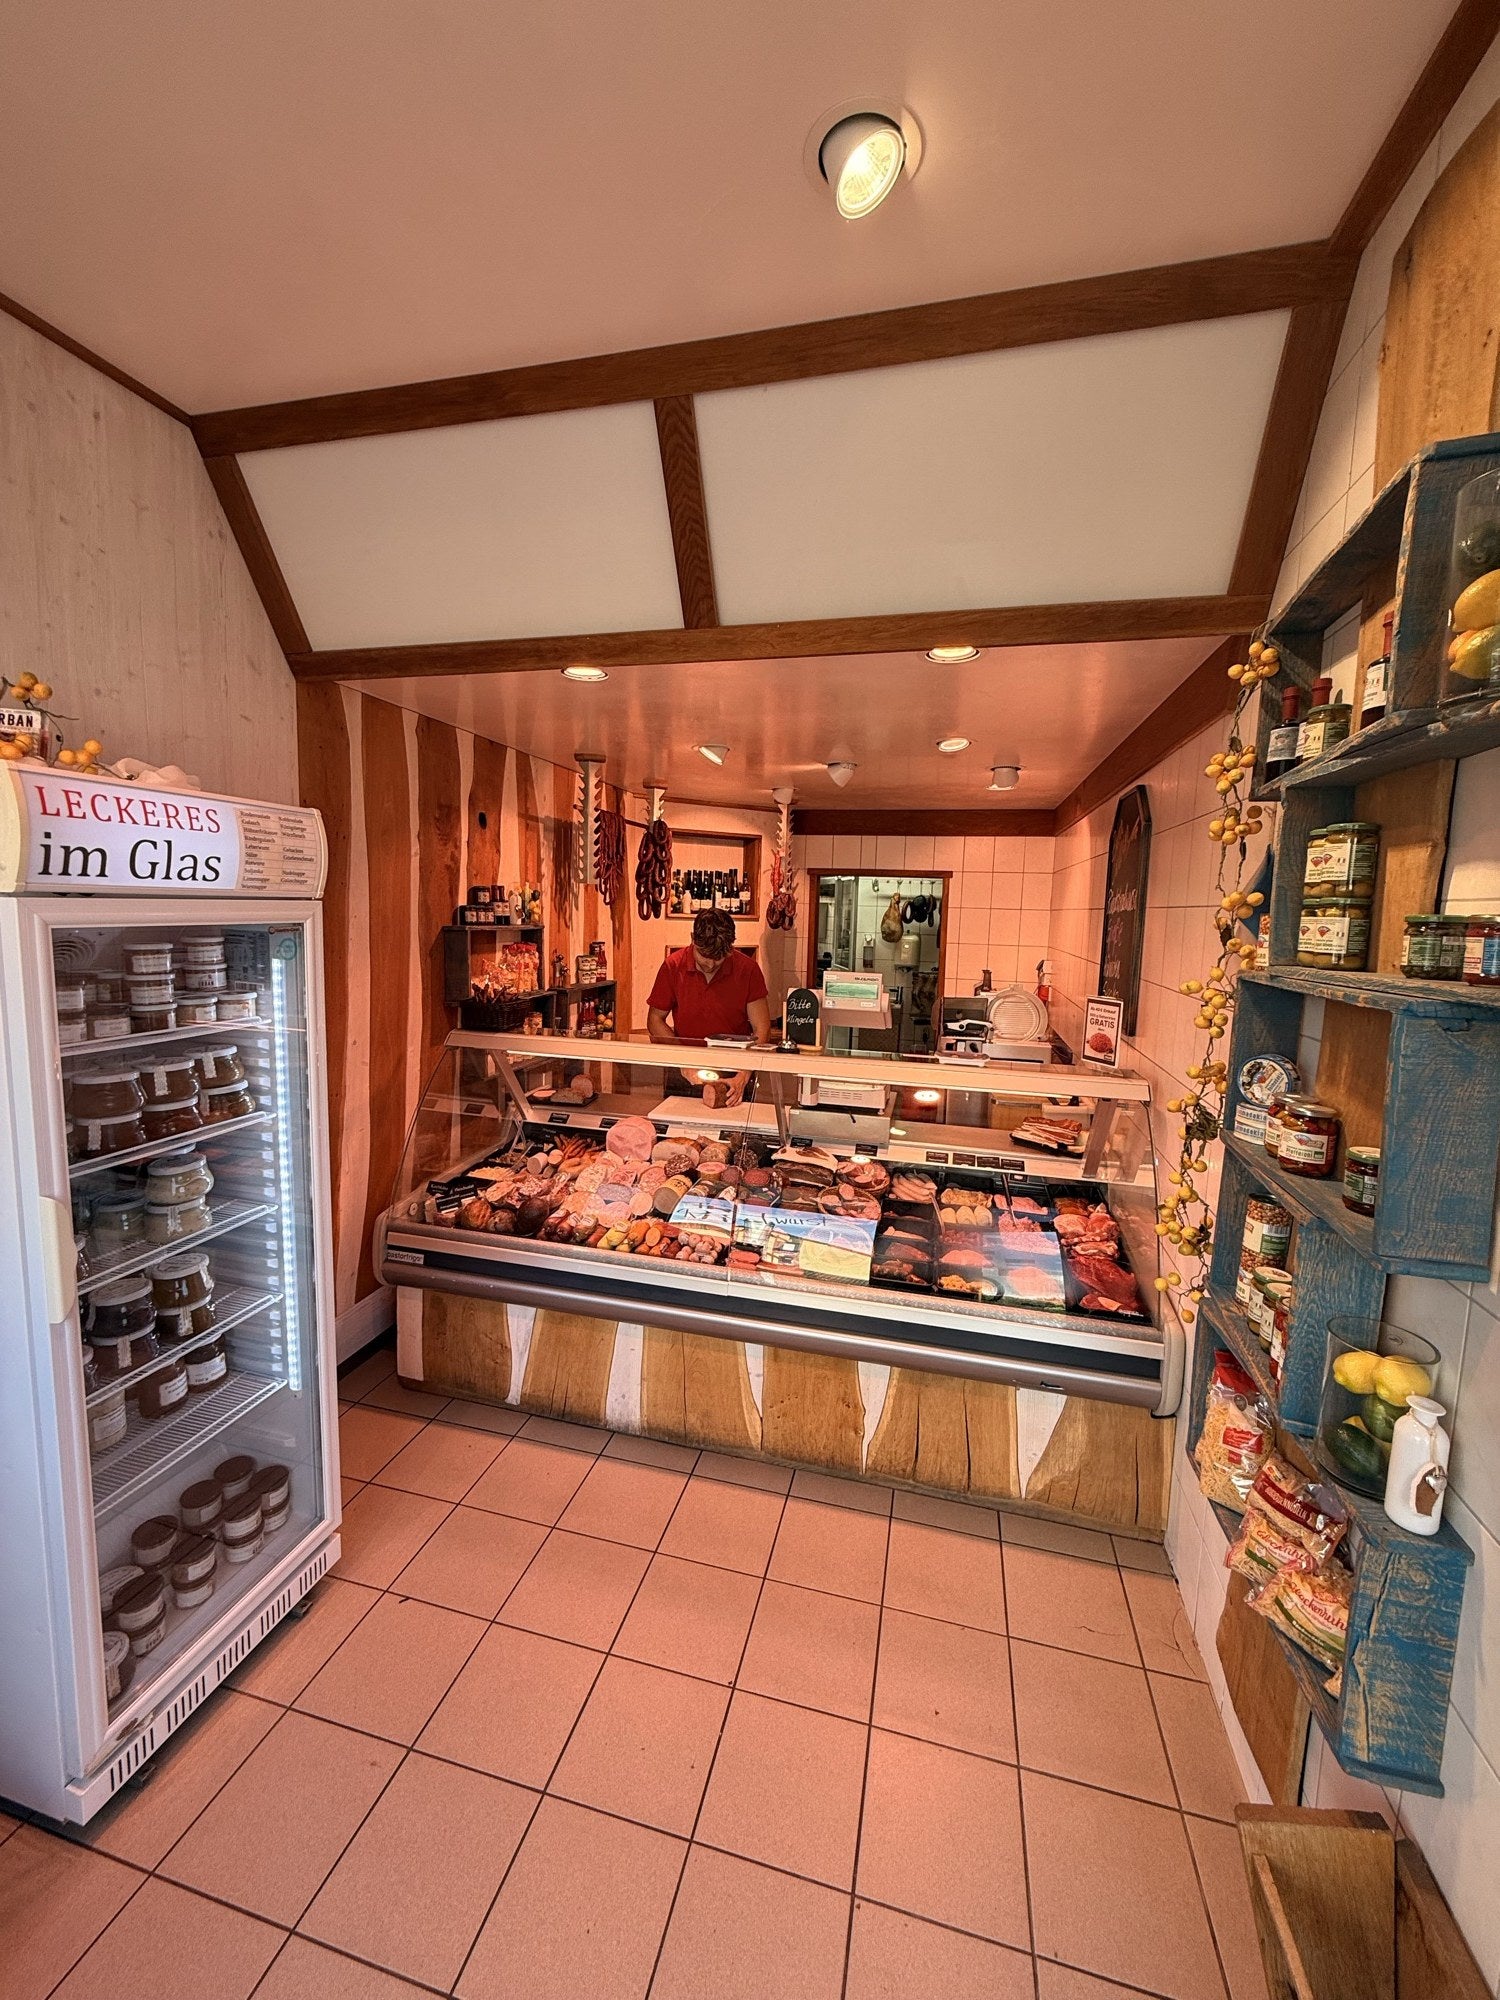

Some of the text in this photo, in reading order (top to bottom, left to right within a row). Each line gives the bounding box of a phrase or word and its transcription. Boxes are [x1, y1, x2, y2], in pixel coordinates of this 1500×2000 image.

[34, 786, 220, 833] LECKERES
[38, 832, 221, 882] im Glas
[788, 999, 811, 1010] Bitte
[1090, 1018, 1115, 1029] GRATIS
